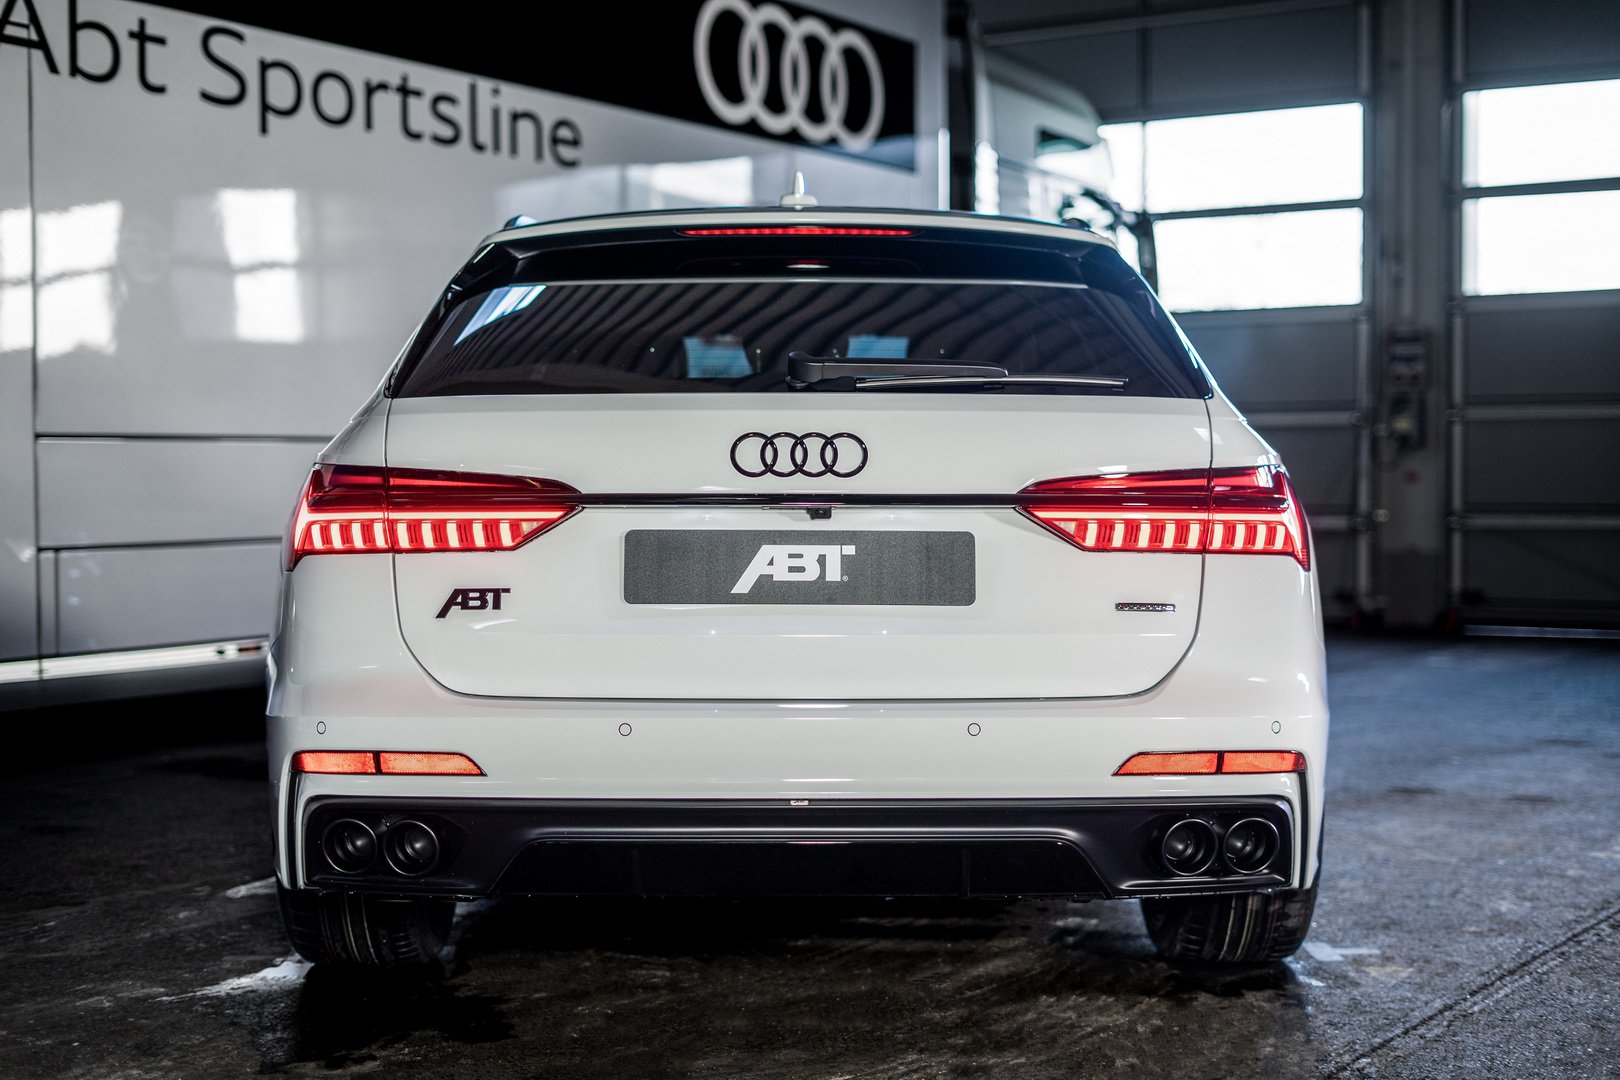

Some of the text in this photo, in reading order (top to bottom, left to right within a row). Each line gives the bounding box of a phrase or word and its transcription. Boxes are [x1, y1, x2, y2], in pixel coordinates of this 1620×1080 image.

[0, 0, 583, 169] Abt Sportsline
[730, 544, 856, 594] ABT
[435, 587, 511, 619] ABT
